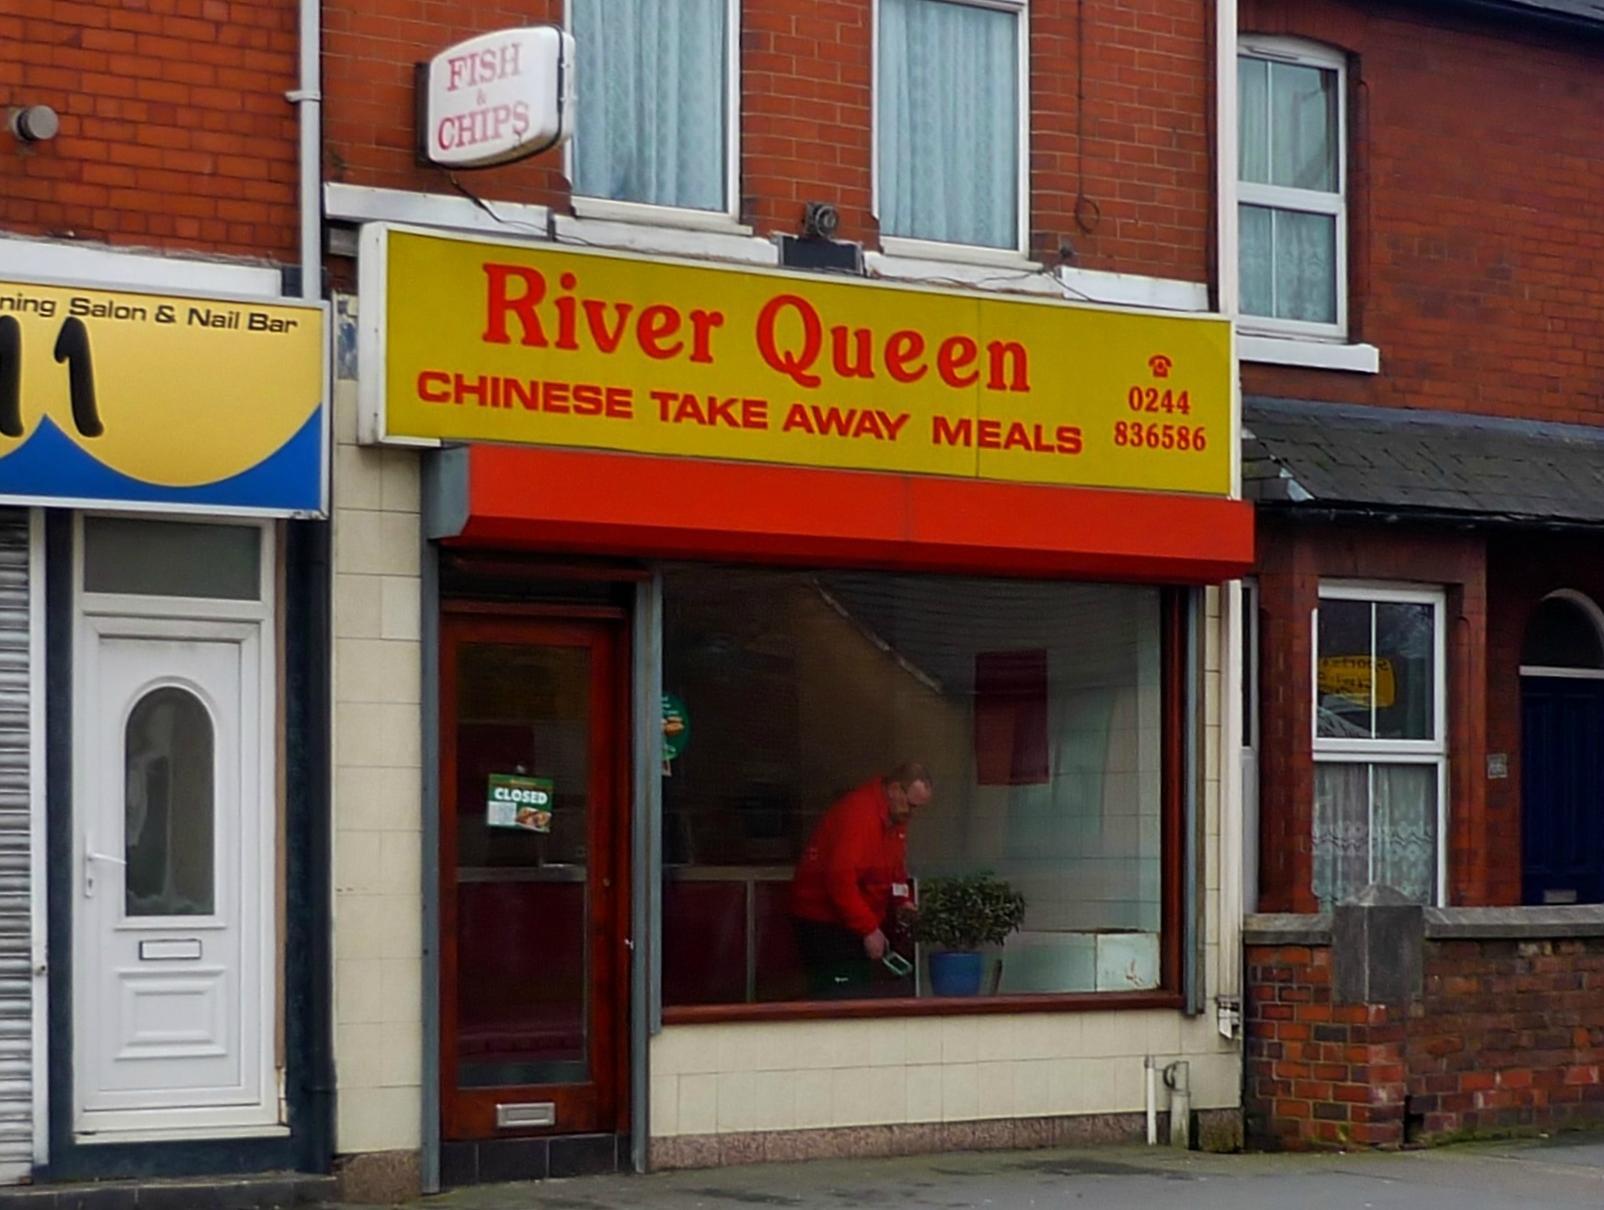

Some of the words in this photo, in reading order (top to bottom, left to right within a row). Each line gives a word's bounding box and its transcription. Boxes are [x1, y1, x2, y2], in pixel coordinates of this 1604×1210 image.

[447, 43, 521, 92] FISH
[438, 100, 530, 150] CHIPS
[69, 297, 147, 321] Salon
[155, 305, 176, 324] &
[187, 309, 240, 331] Nail
[247, 313, 298, 334] Bar
[482, 262, 724, 364] River
[756, 294, 1030, 392] Queen
[417, 370, 633, 419] CHINESE
[650, 391, 768, 430] TAKE
[782, 403, 910, 441] AWAY
[932, 416, 1083, 455] MEALS
[1128, 385, 1191, 416] 0244
[1114, 420, 1207, 452] 836586
[494, 787, 548, 805] CLOSED
